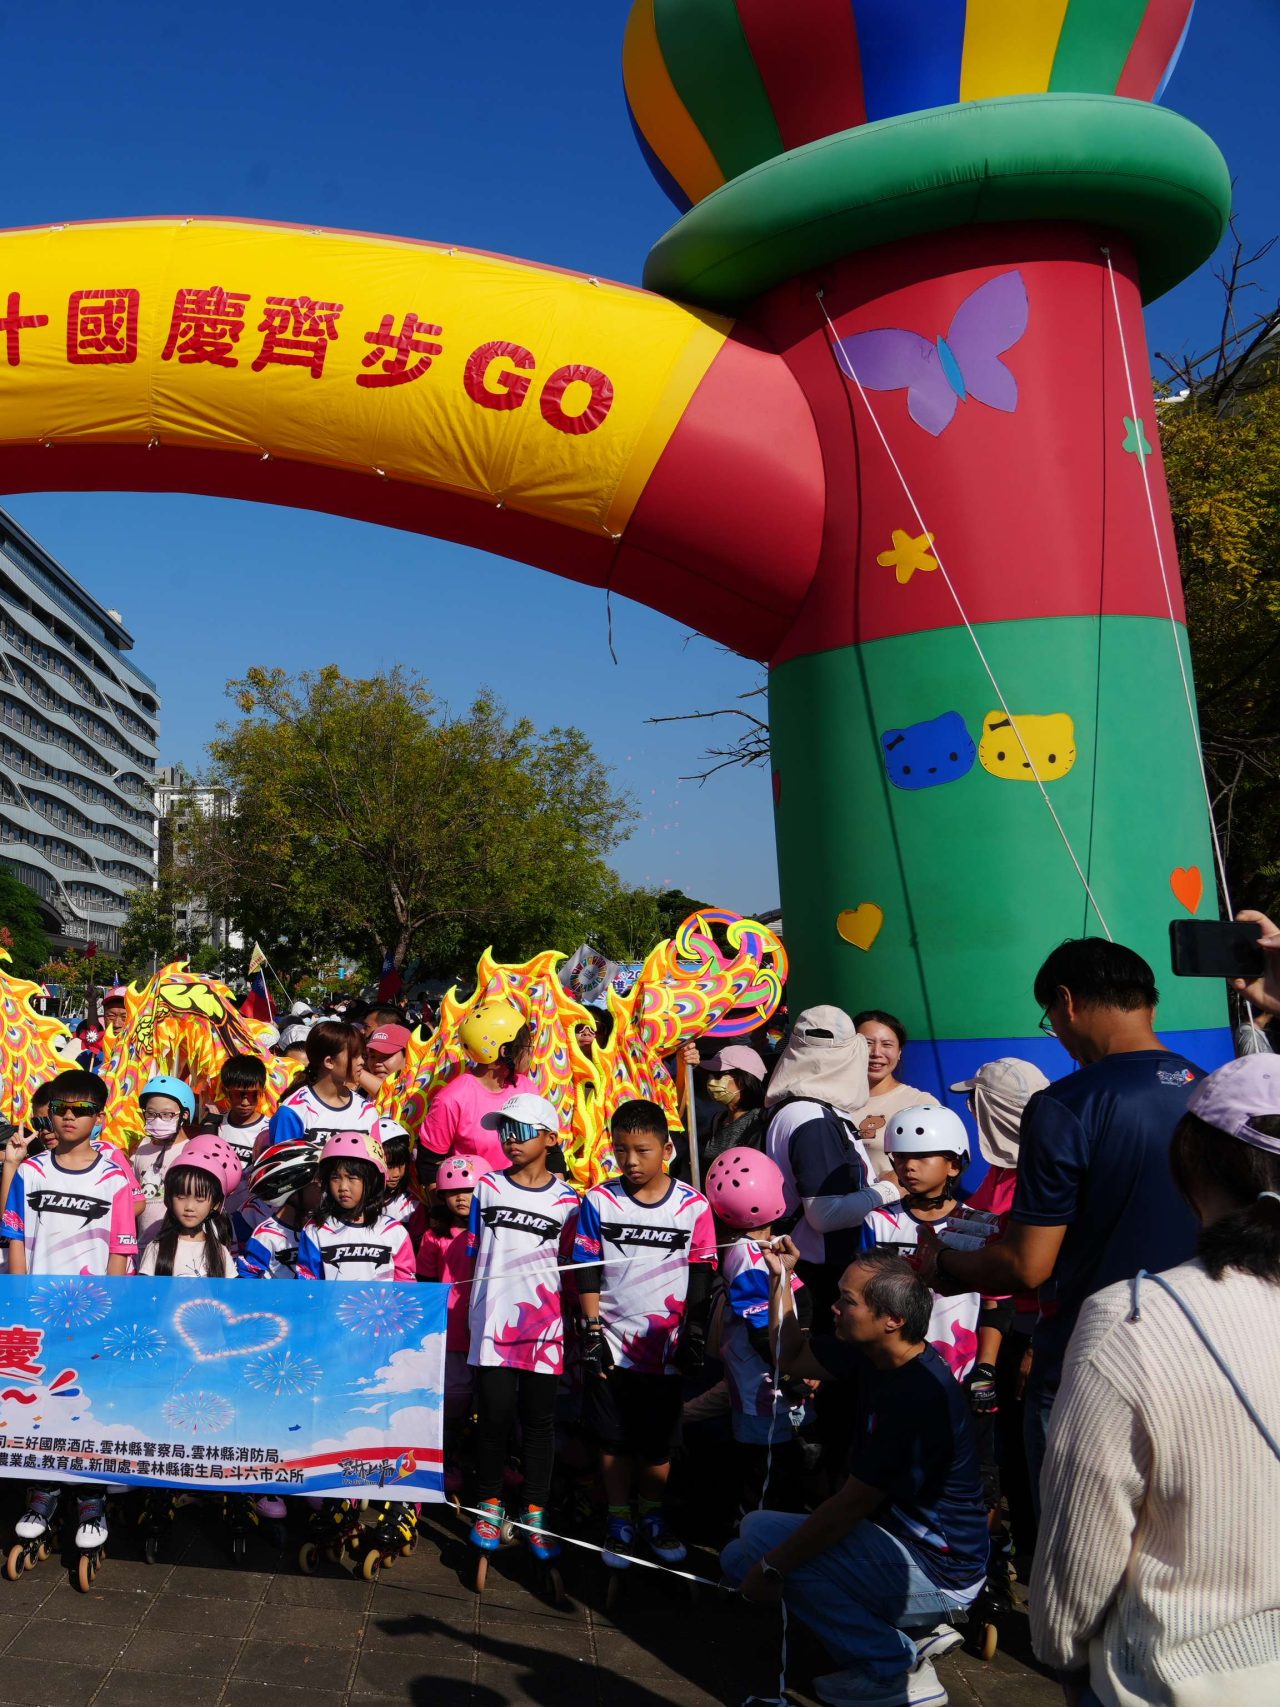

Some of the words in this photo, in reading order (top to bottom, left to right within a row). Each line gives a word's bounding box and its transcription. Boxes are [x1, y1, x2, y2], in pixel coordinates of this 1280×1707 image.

[38, 1194, 98, 1211] FLAME
[489, 1210, 554, 1231] FLAME
[613, 1228, 678, 1242] FLAME
[334, 1247, 384, 1259] FLAME
